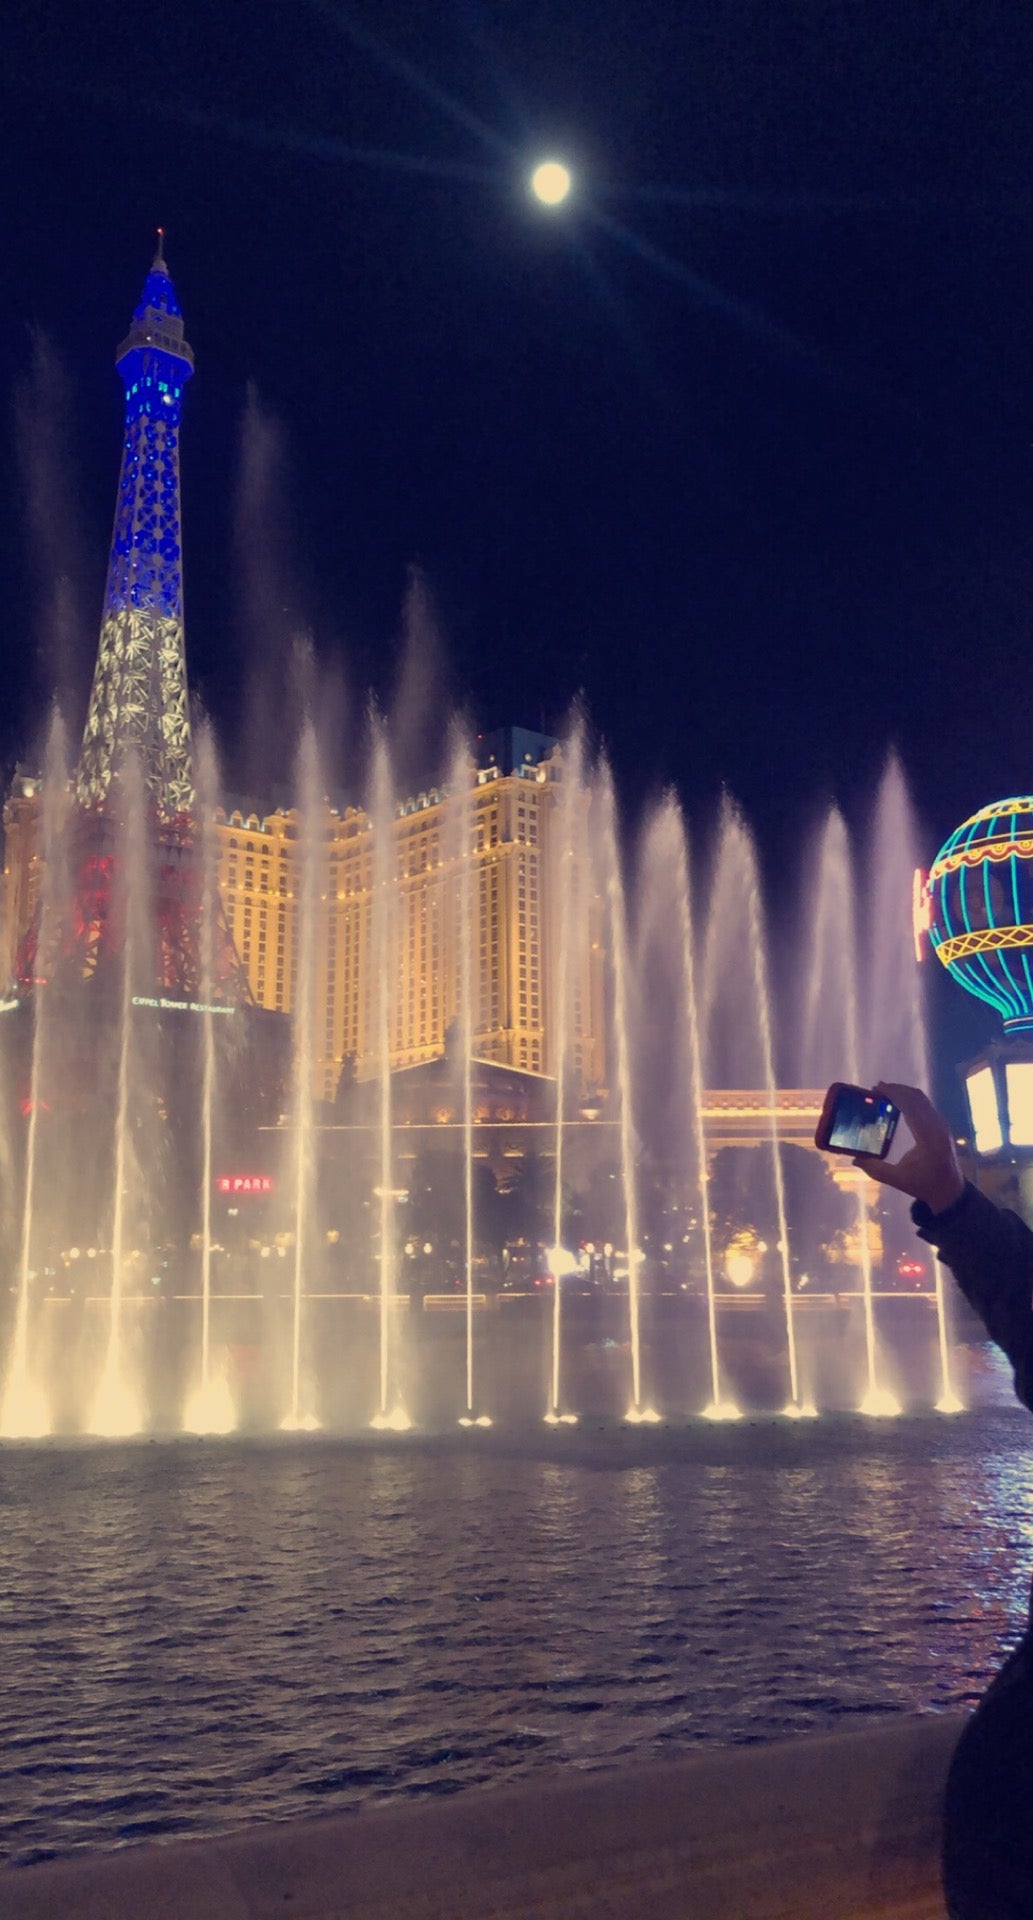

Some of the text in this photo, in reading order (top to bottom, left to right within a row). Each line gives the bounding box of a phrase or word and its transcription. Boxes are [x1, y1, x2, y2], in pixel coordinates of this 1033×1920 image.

[160, 998, 188, 1010] TOWER
[190, 1002, 235, 1014] RESTAURANT
[233, 1178, 271, 1191] PARK
